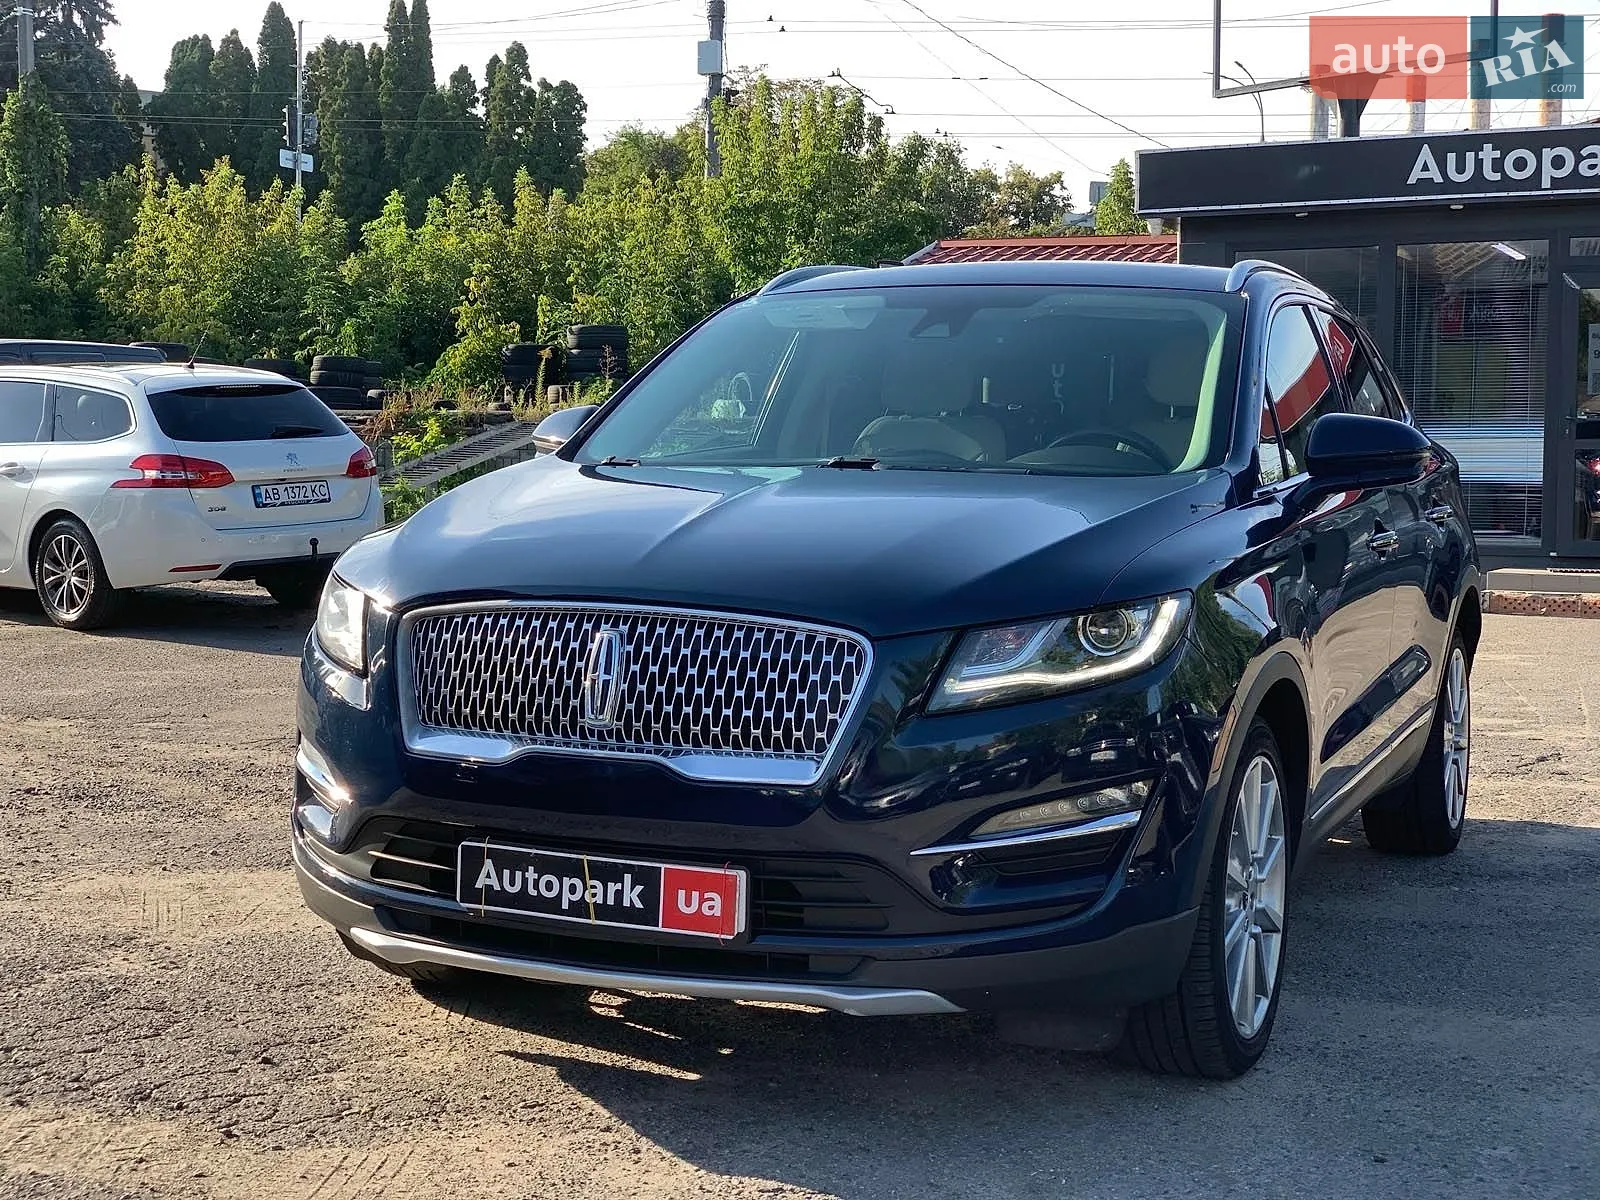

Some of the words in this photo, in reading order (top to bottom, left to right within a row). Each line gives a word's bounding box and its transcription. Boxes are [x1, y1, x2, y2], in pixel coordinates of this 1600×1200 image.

[1406, 141, 1600, 189] Autopa
[264, 487, 281, 502] AB
[283, 485, 309, 500] 1372
[310, 484, 327, 498] KC
[474, 858, 645, 910] Autopark
[676, 887, 722, 917] ua
